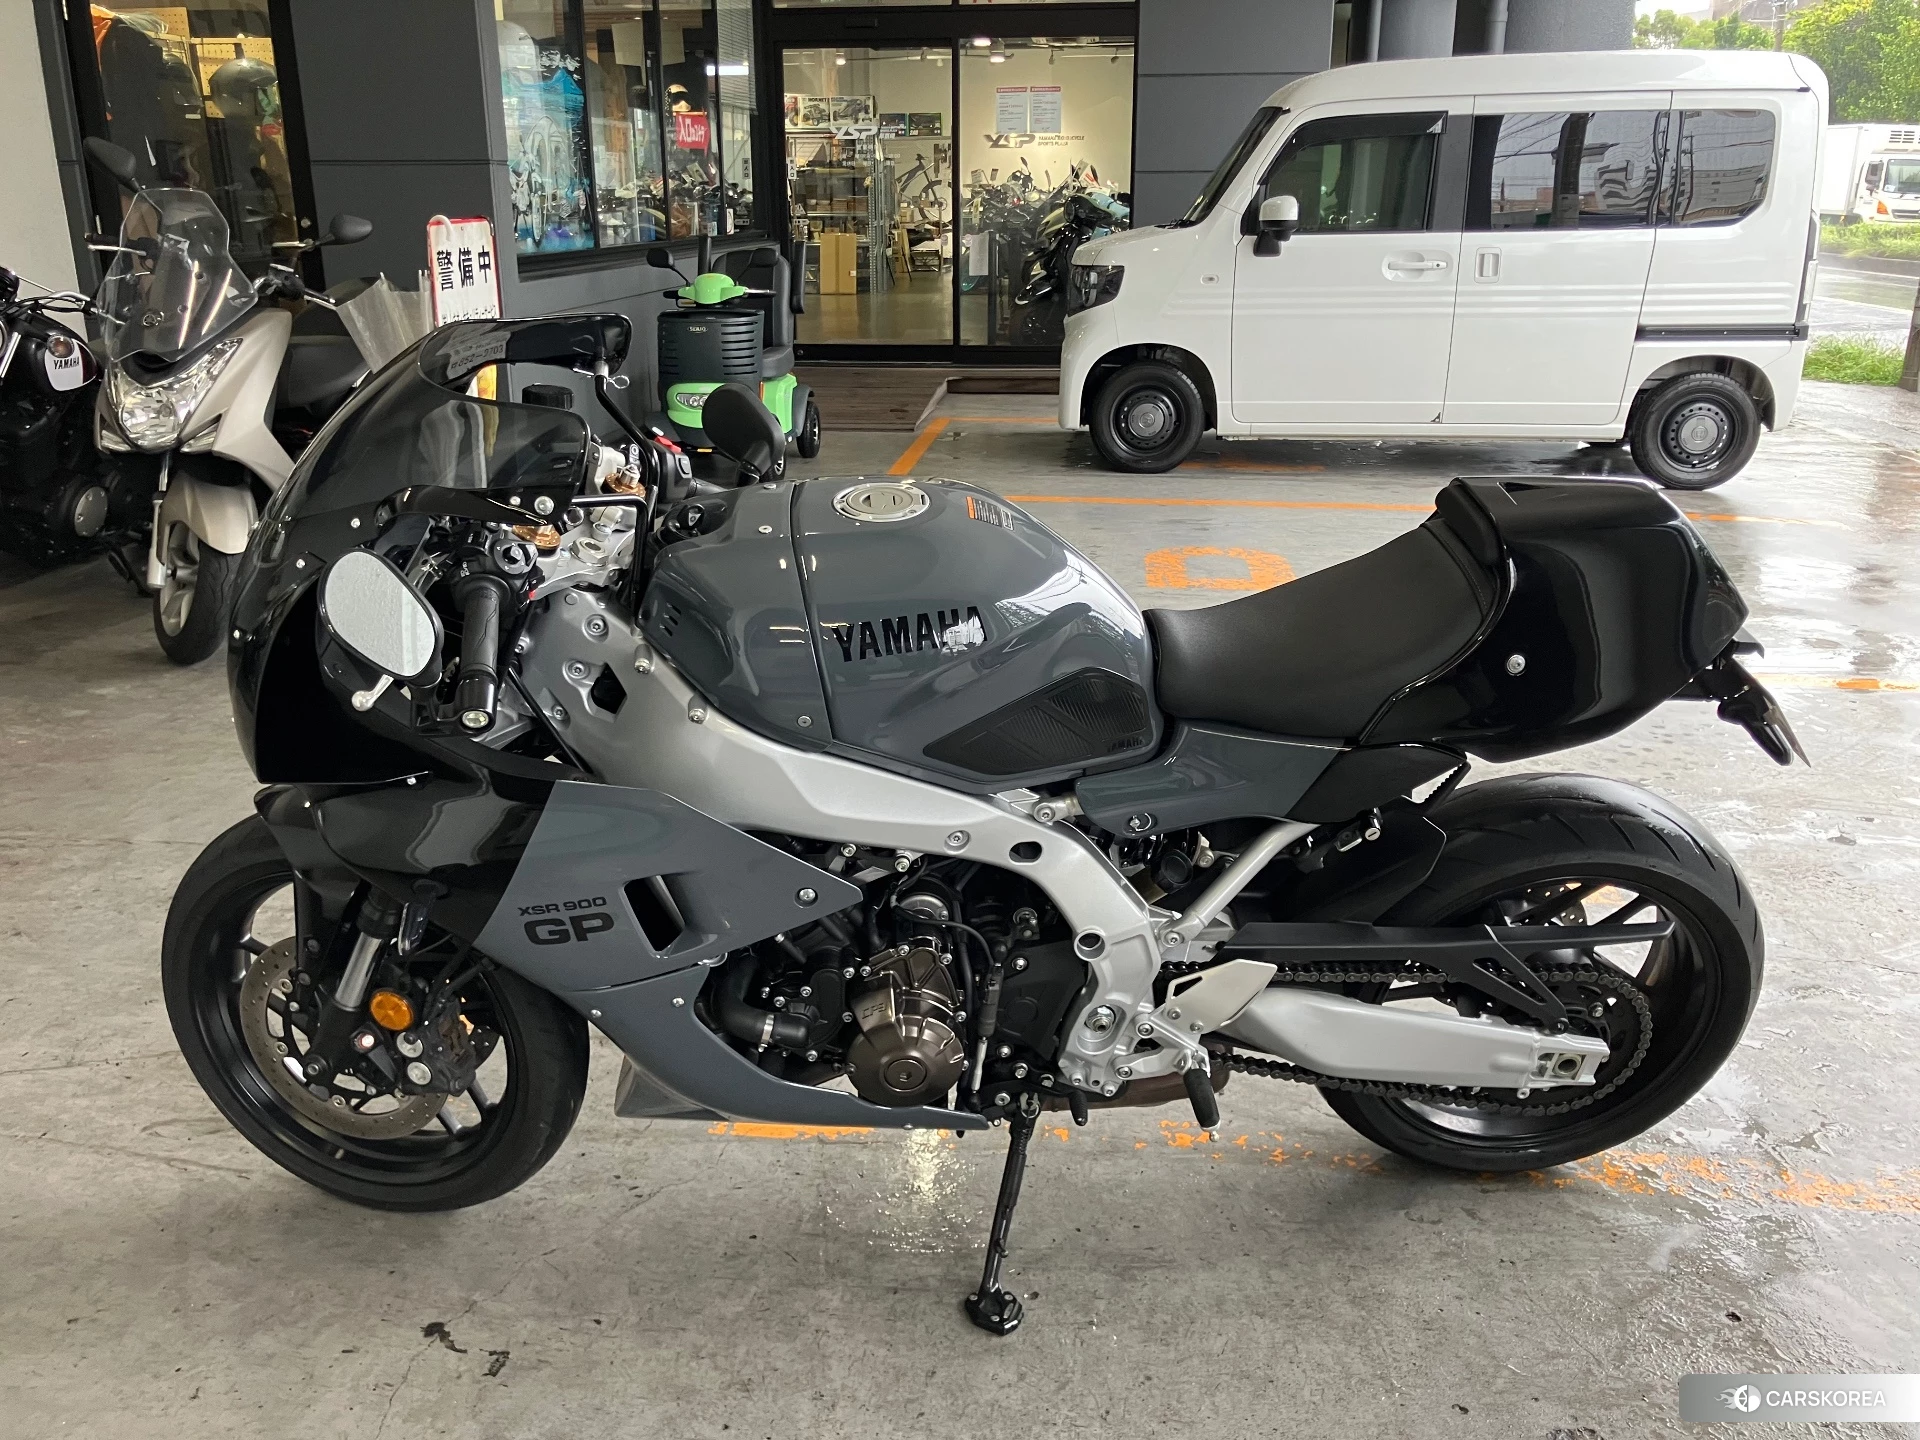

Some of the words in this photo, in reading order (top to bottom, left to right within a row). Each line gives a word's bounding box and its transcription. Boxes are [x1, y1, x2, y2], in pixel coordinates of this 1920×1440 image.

[829, 125, 878, 140] YSP
[436, 245, 492, 291] 警備中
[53, 356, 79, 370] YAMAHA
[831, 606, 987, 662] YAMAHA
[517, 903, 561, 916] XSR
[563, 896, 607, 911] 900
[523, 912, 614, 945] GP
